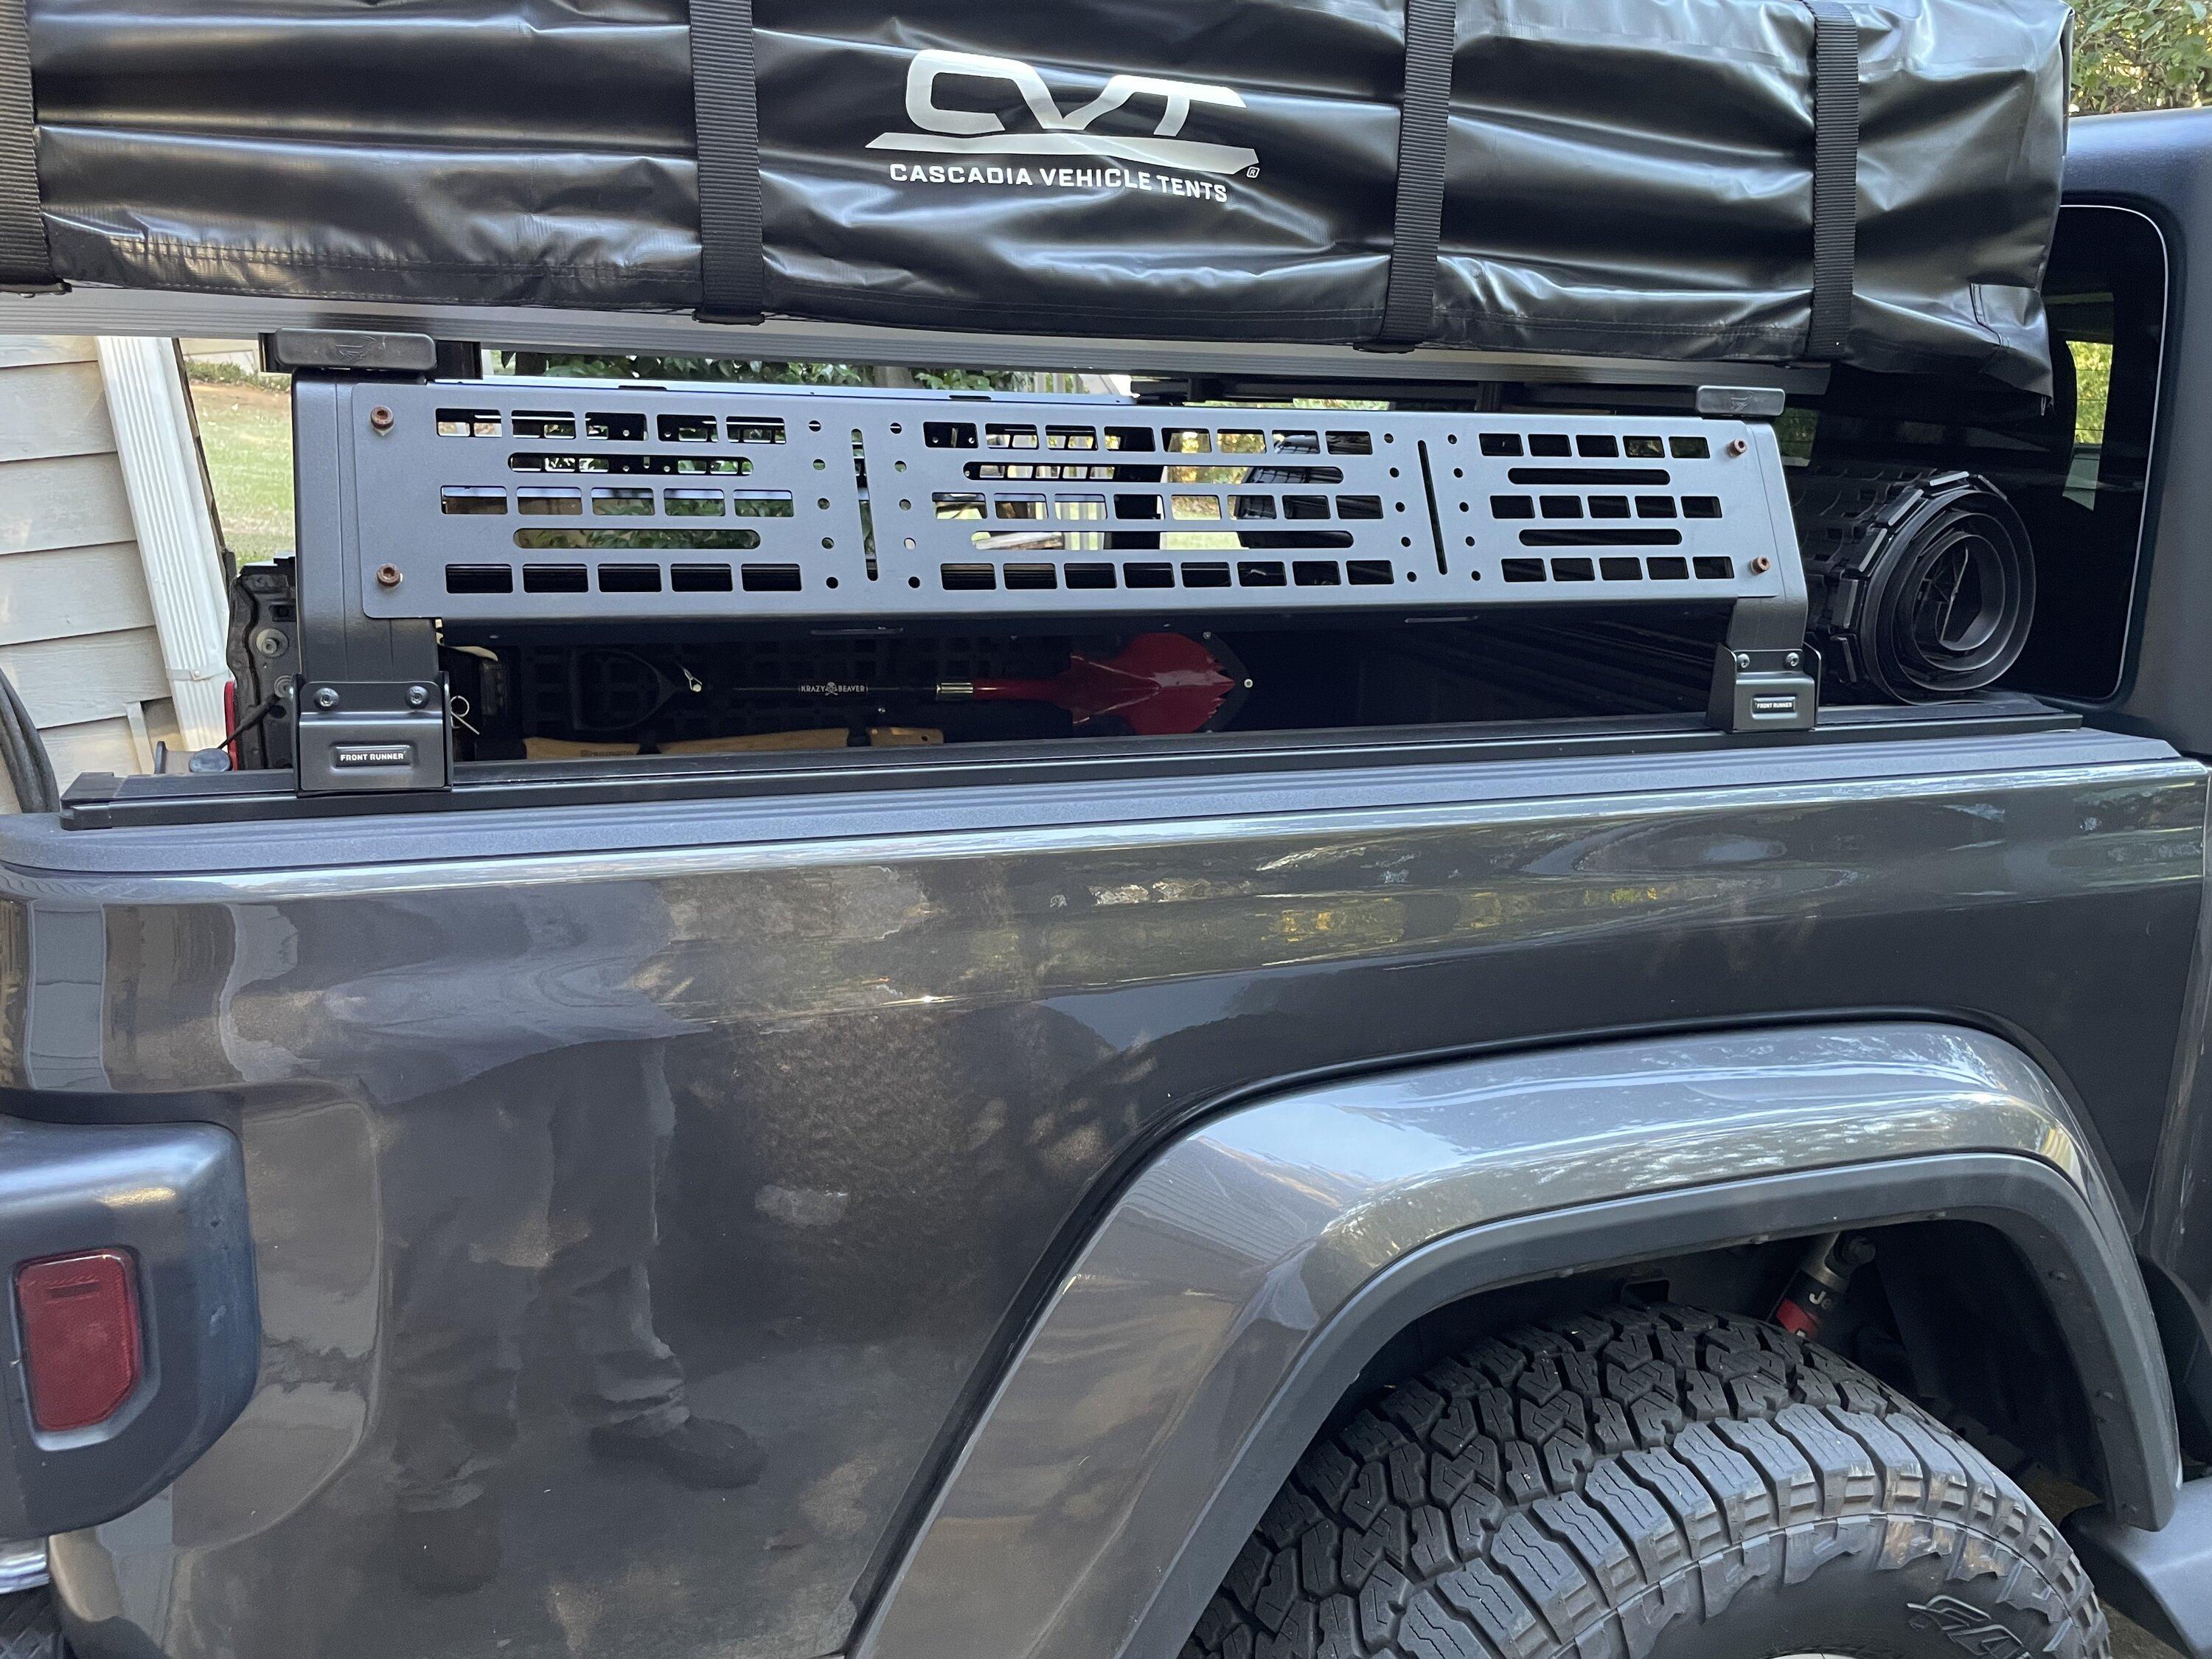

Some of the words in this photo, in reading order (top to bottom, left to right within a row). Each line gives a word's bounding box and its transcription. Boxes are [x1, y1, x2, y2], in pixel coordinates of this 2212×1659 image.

[905, 49, 1247, 136] CVT
[889, 163, 1033, 186] CASCADIA
[1040, 168, 1152, 191] VEHICLE
[1156, 175, 1228, 203] TENTS
[340, 754, 368, 762] FRONT
[369, 753, 404, 761] RUNNER
